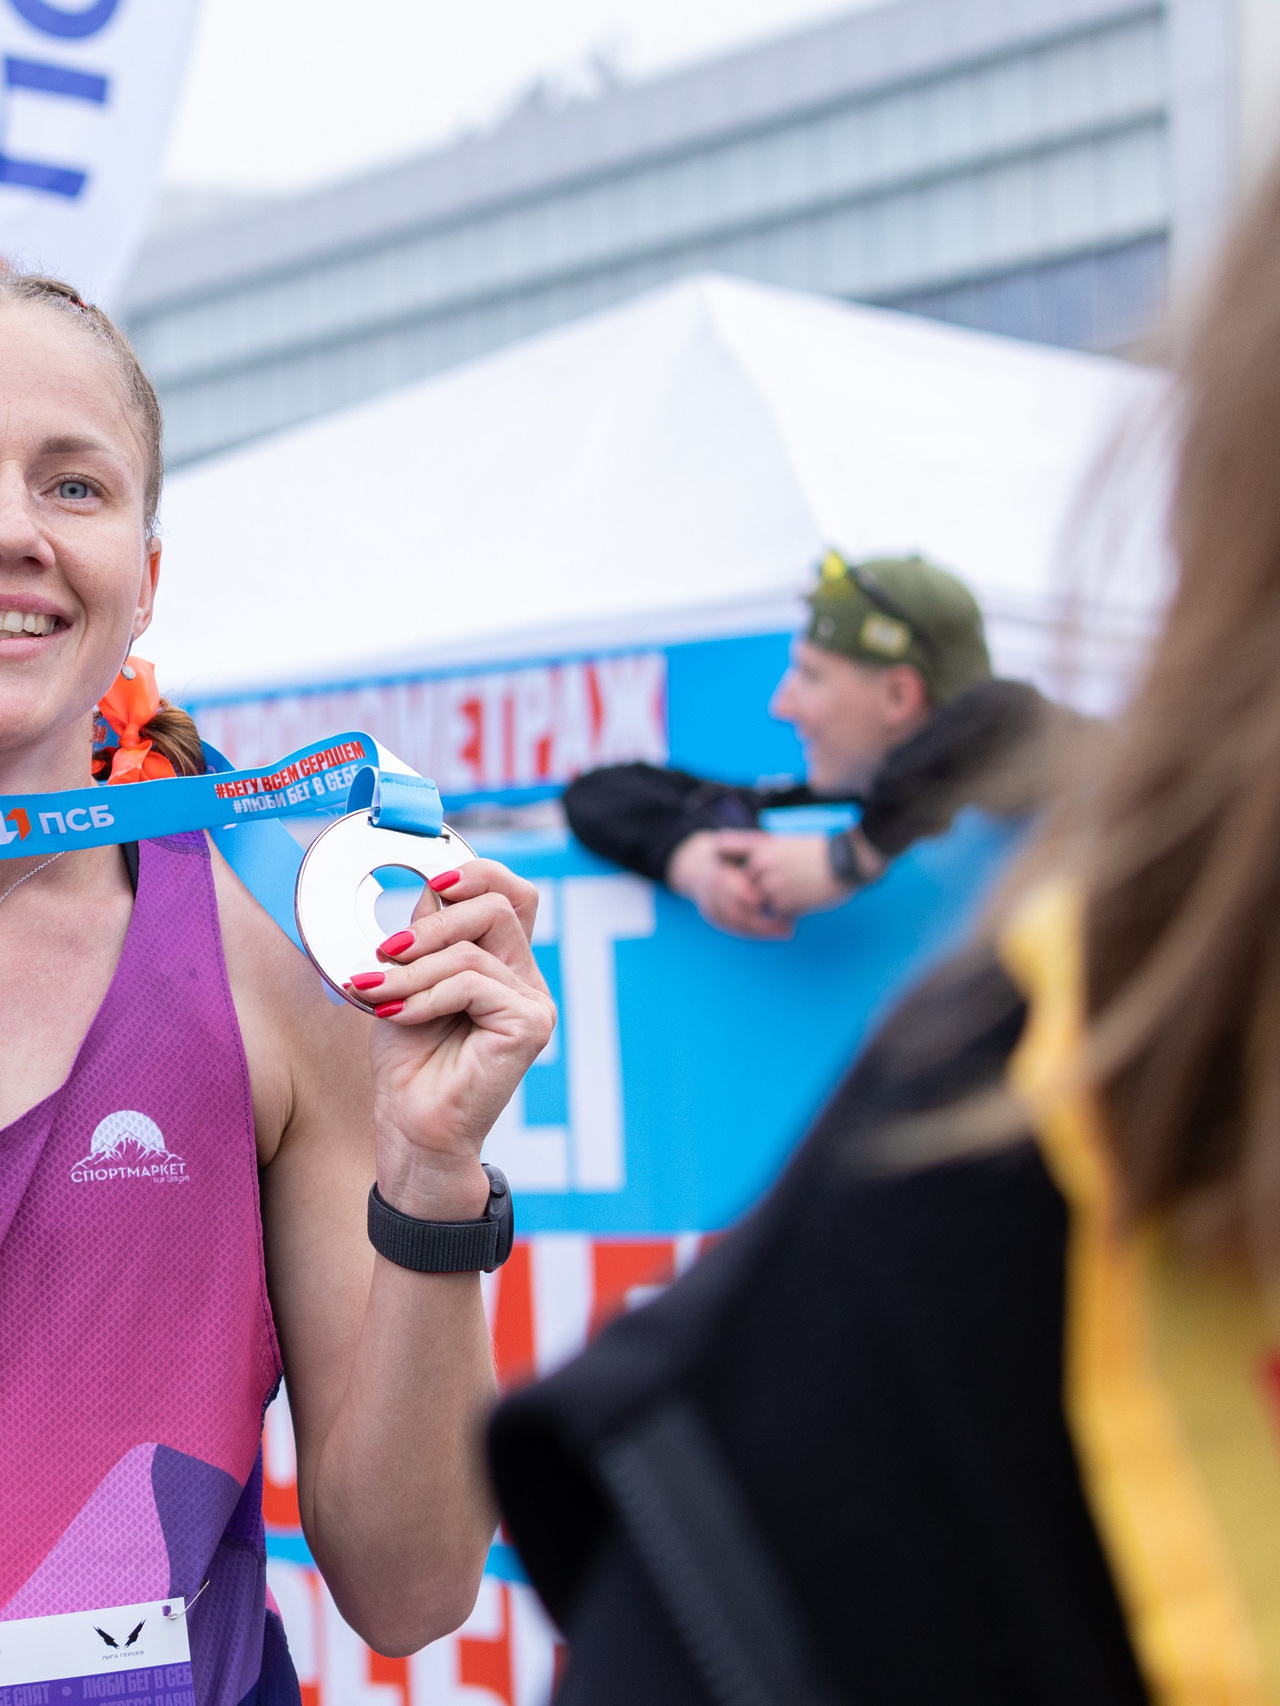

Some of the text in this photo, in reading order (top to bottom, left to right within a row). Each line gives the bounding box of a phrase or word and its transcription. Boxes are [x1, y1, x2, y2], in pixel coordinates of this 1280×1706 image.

[215, 741, 366, 799] #БЕГУ ВСЕМ СЕРДЦЕМ
[233, 793, 287, 814] #ЛЮБИ
[287, 781, 311, 805] БЕГ
[312, 778, 326, 796] В
[40, 804, 115, 836] ПСБ
[71, 1162, 187, 1183] СПОРТМАРКЕТ
[13, 1684, 50, 1706] СПЯТ
[83, 1673, 125, 1699] ЛЮБИ
[127, 1669, 152, 1693] БЕГ
[154, 1668, 165, 1689] В
